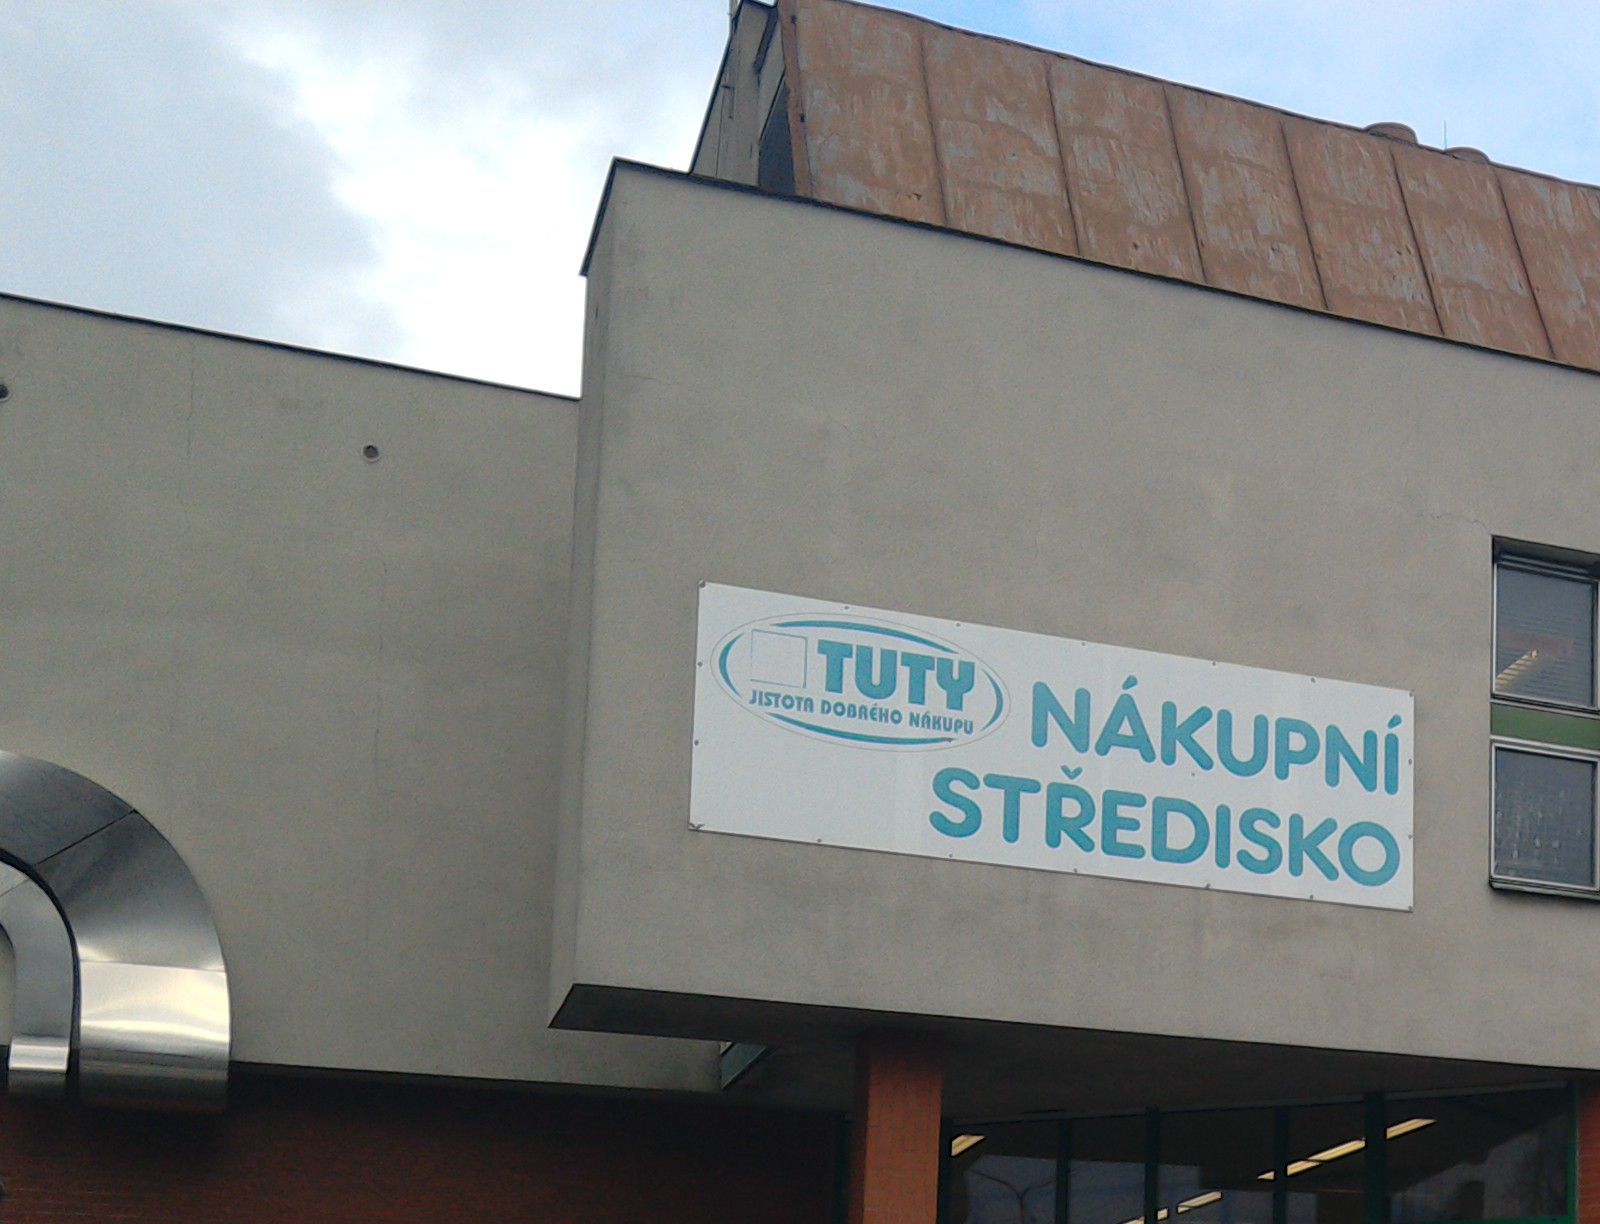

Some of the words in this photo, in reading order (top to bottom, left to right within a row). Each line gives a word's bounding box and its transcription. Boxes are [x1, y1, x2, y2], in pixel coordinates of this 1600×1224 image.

[749, 689, 815, 713] JISTOTA
[820, 699, 903, 725] DOBRÉHO
[909, 710, 974, 735] NÁKUPU
[817, 639, 975, 711] TUTY
[1031, 675, 1403, 796] NÁKUPNÍ
[929, 764, 1401, 887] STŘEDISKO
